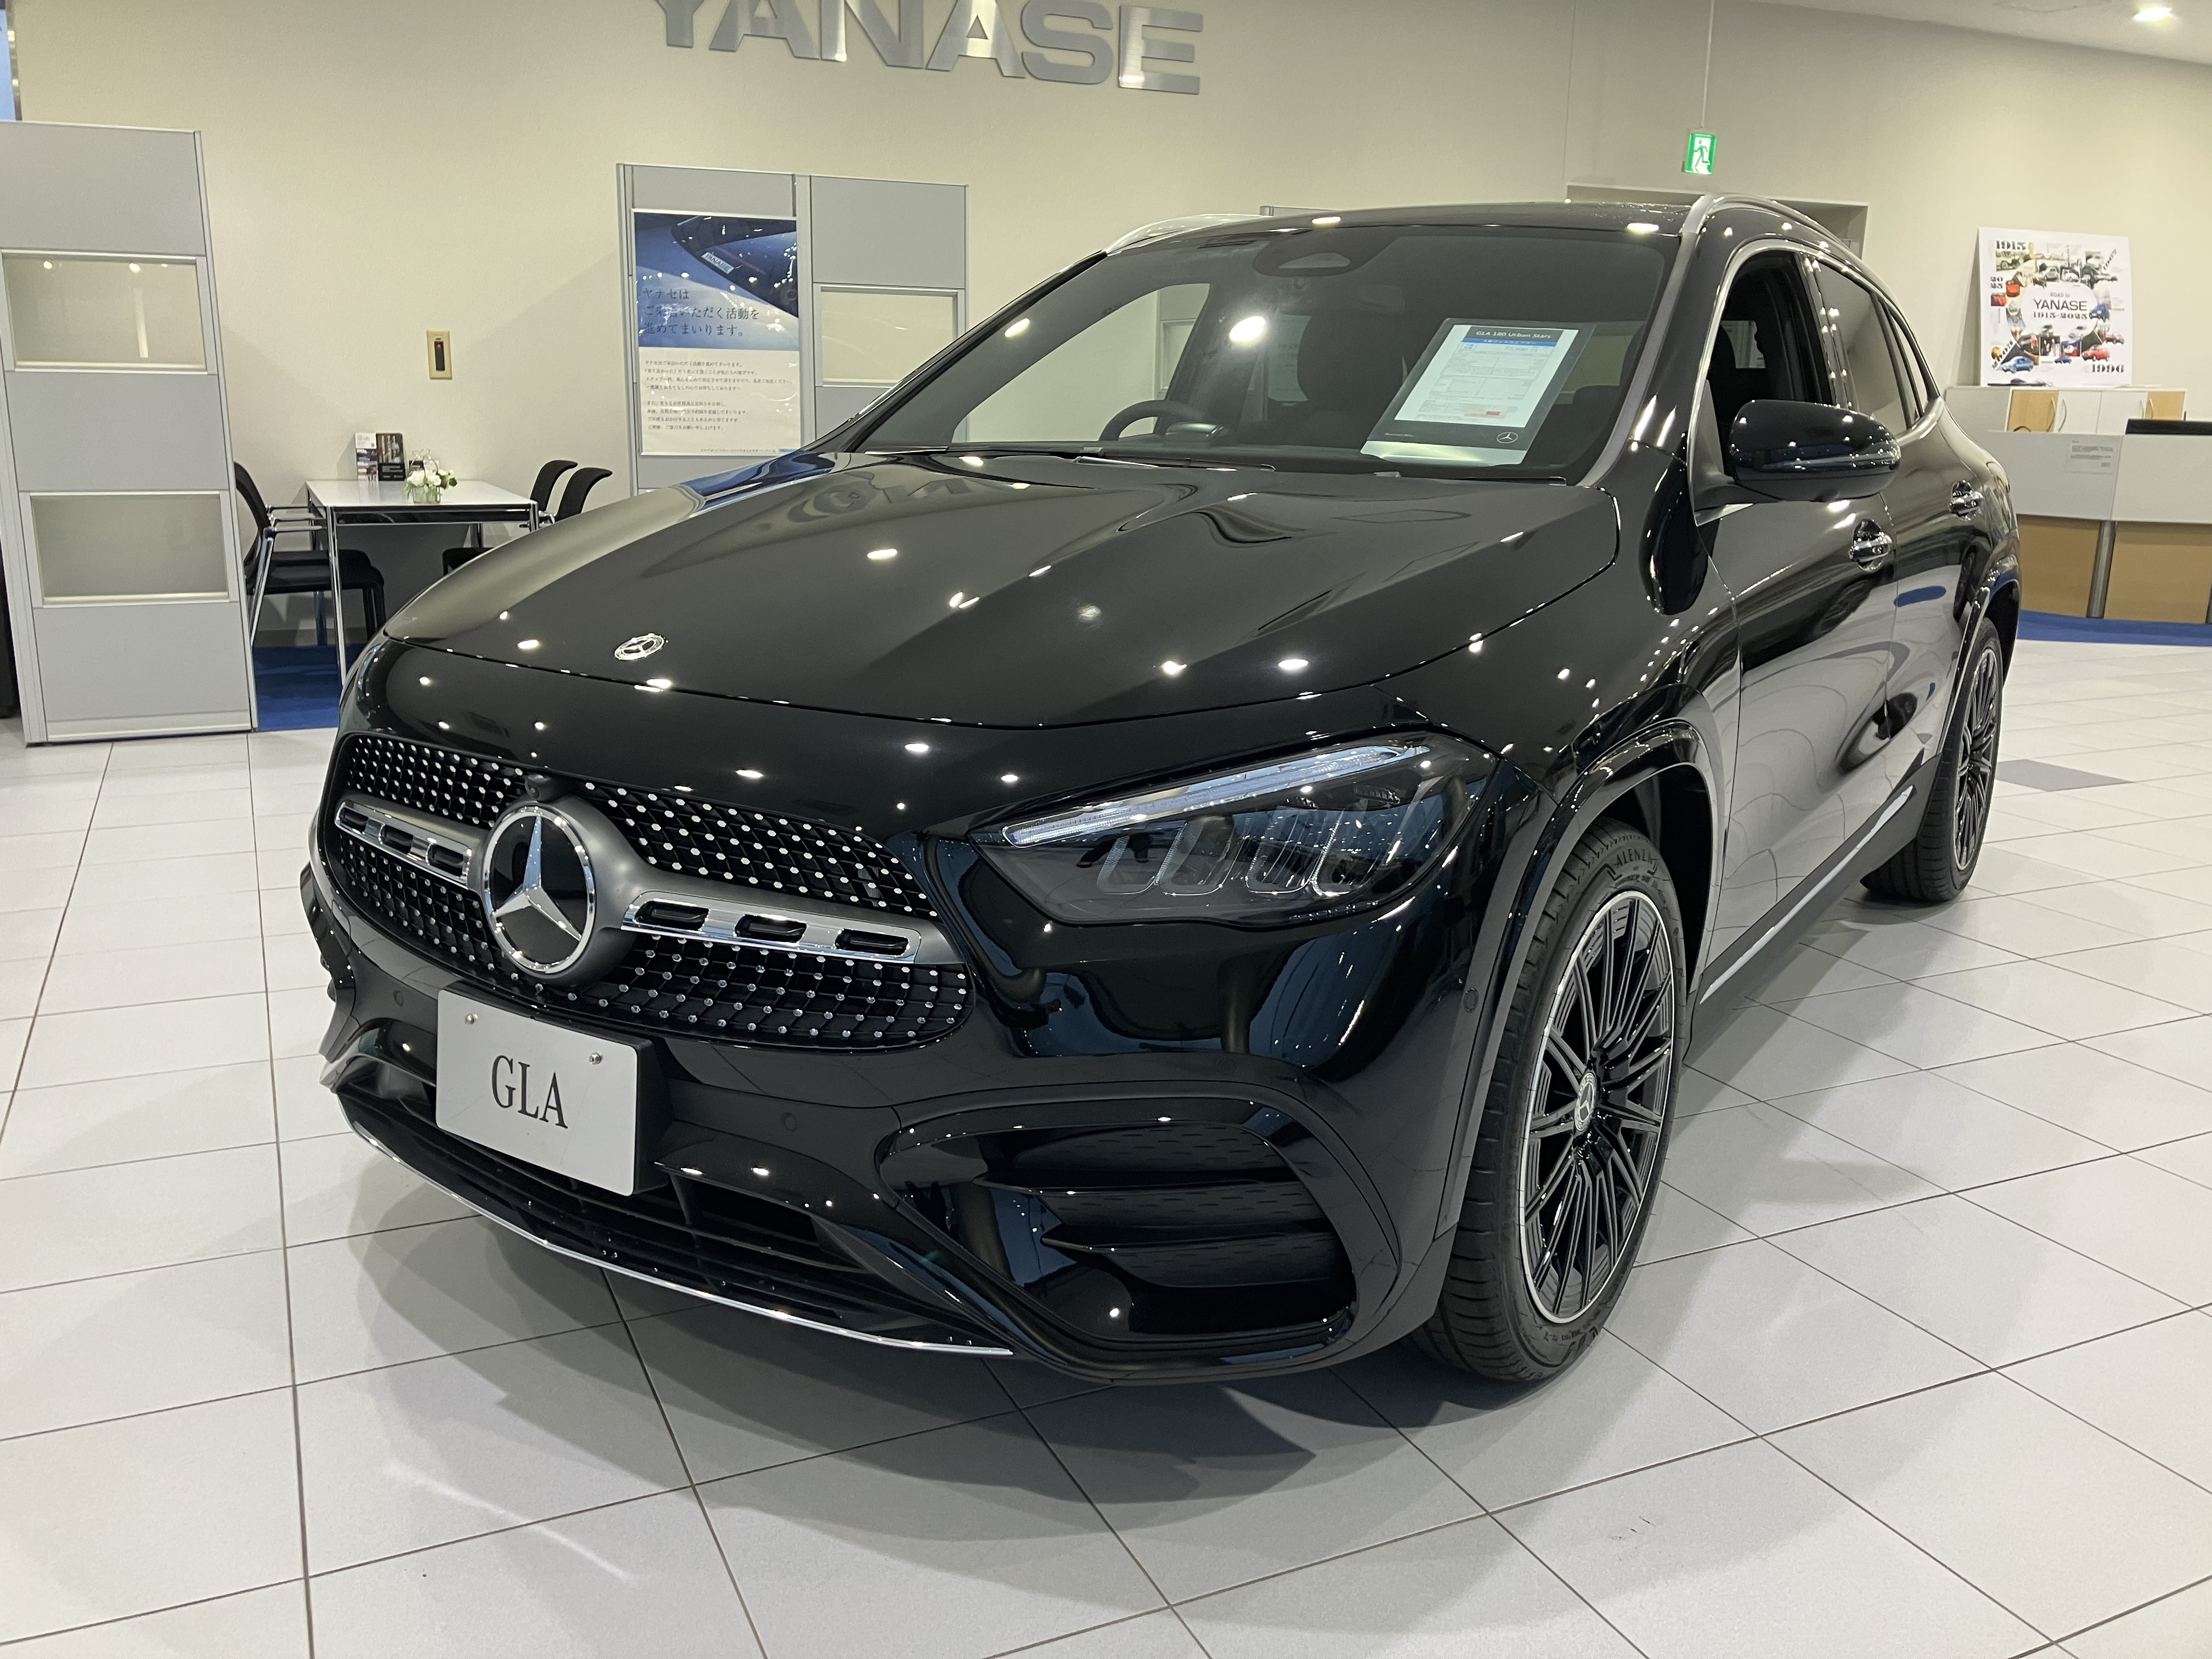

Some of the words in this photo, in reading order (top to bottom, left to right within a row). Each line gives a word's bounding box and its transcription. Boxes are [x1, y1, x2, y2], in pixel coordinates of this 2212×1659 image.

[652, 0, 1204, 95] YANASE
[1996, 240, 2026, 250] 1915
[643, 287, 690, 300] ヤナセは
[2033, 299, 2087, 311] YANASE
[644, 322, 743, 337] 進めてまいります。
[1615, 848, 1653, 868] ALENZA
[492, 1055, 568, 1129] GLA
